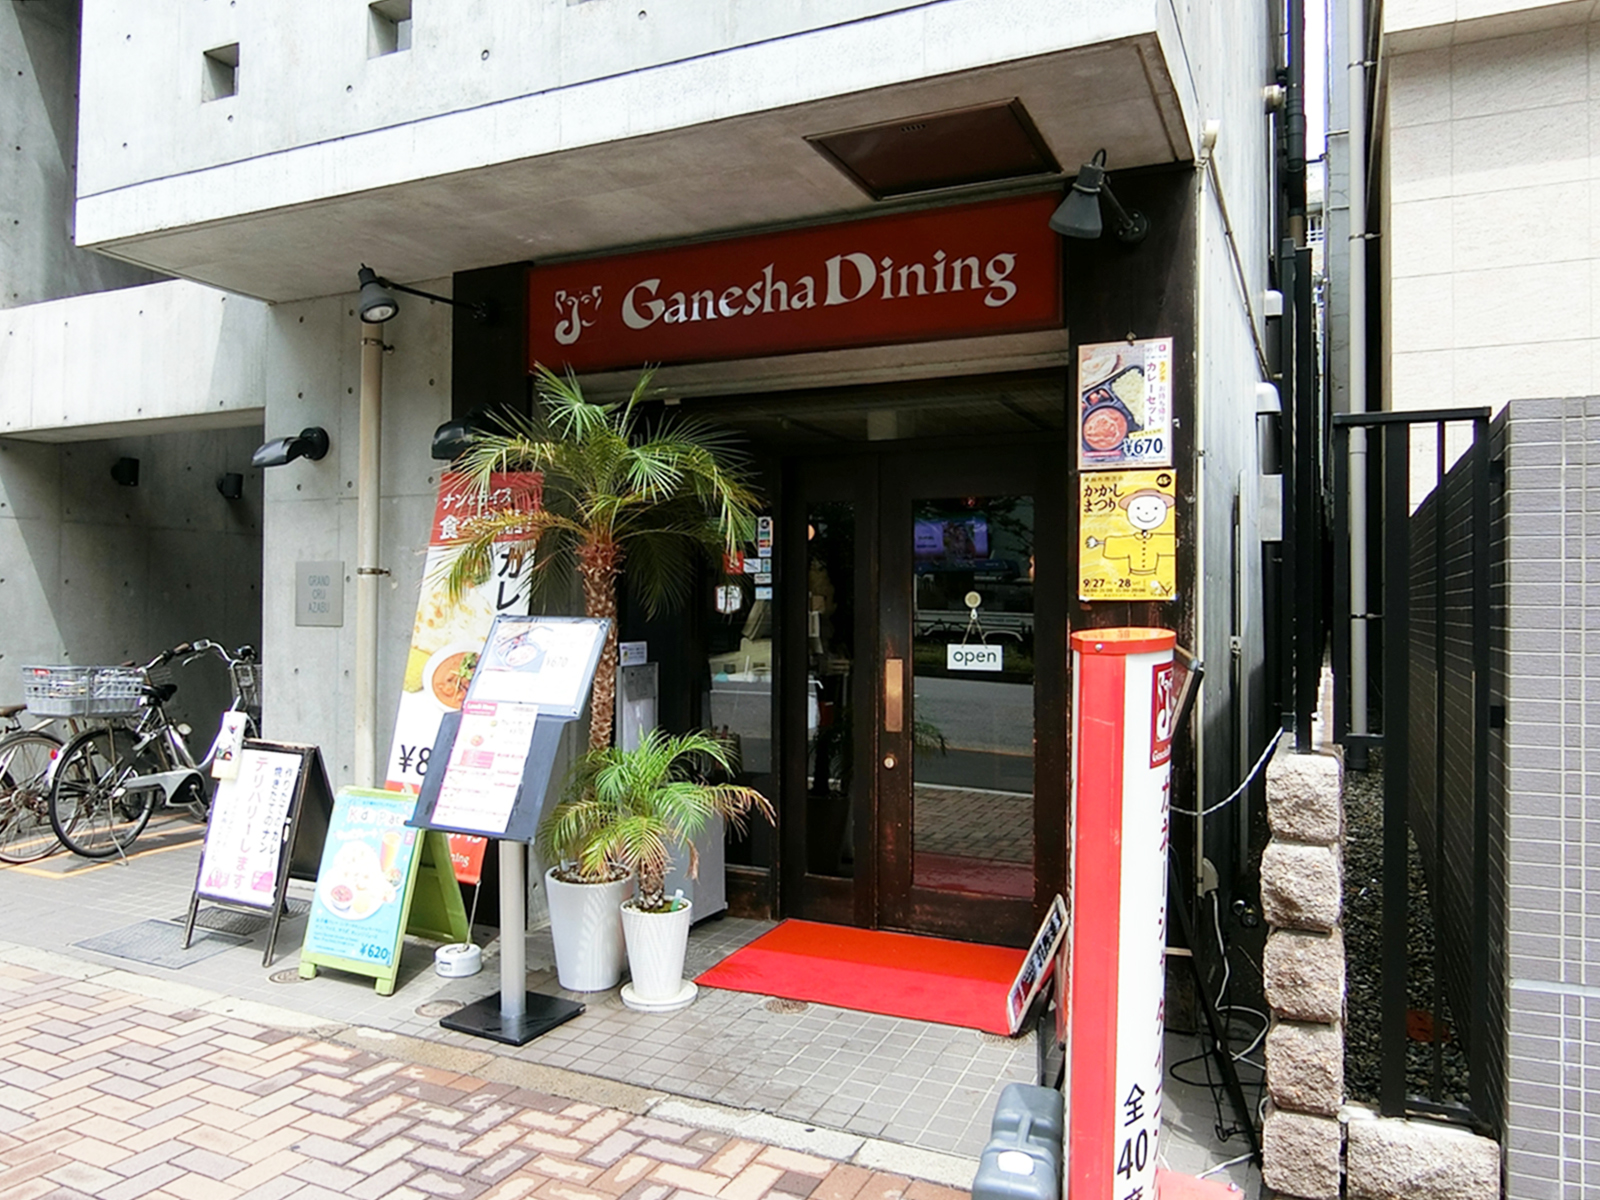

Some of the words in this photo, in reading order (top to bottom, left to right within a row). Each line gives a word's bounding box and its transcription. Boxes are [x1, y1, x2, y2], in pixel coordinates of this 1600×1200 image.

[621, 262, 816, 330] Ganesha
[824, 249, 1018, 307] Dining
[1146, 362, 1157, 426] カレーセット
[1124, 438, 1163, 455] ¥670
[1084, 483, 1125, 498] かかし
[1084, 498, 1116, 513] まつり
[953, 651, 997, 666] open
[360, 943, 389, 960] ¥620
